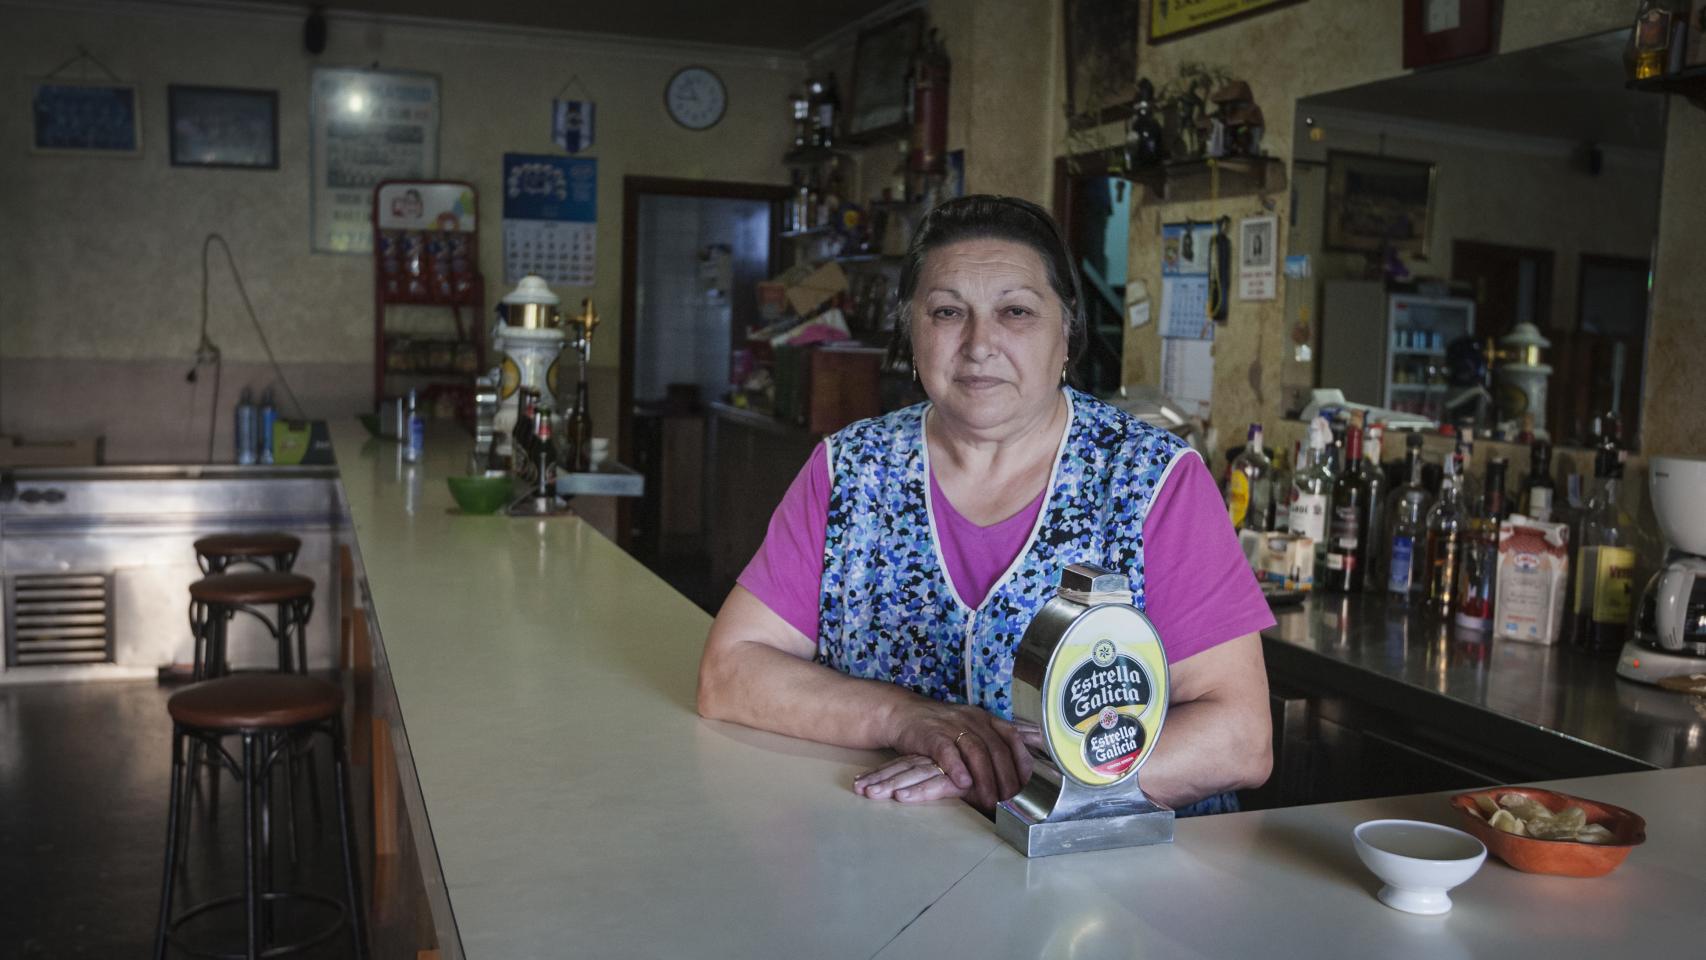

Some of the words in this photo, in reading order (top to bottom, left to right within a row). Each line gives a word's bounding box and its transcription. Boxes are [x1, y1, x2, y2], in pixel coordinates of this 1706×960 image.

[1071, 665, 1141, 702] Estrella
[1075, 684, 1140, 717] Galicia
[1091, 725, 1137, 751] Estrella
[1095, 739, 1137, 762] Galicia
